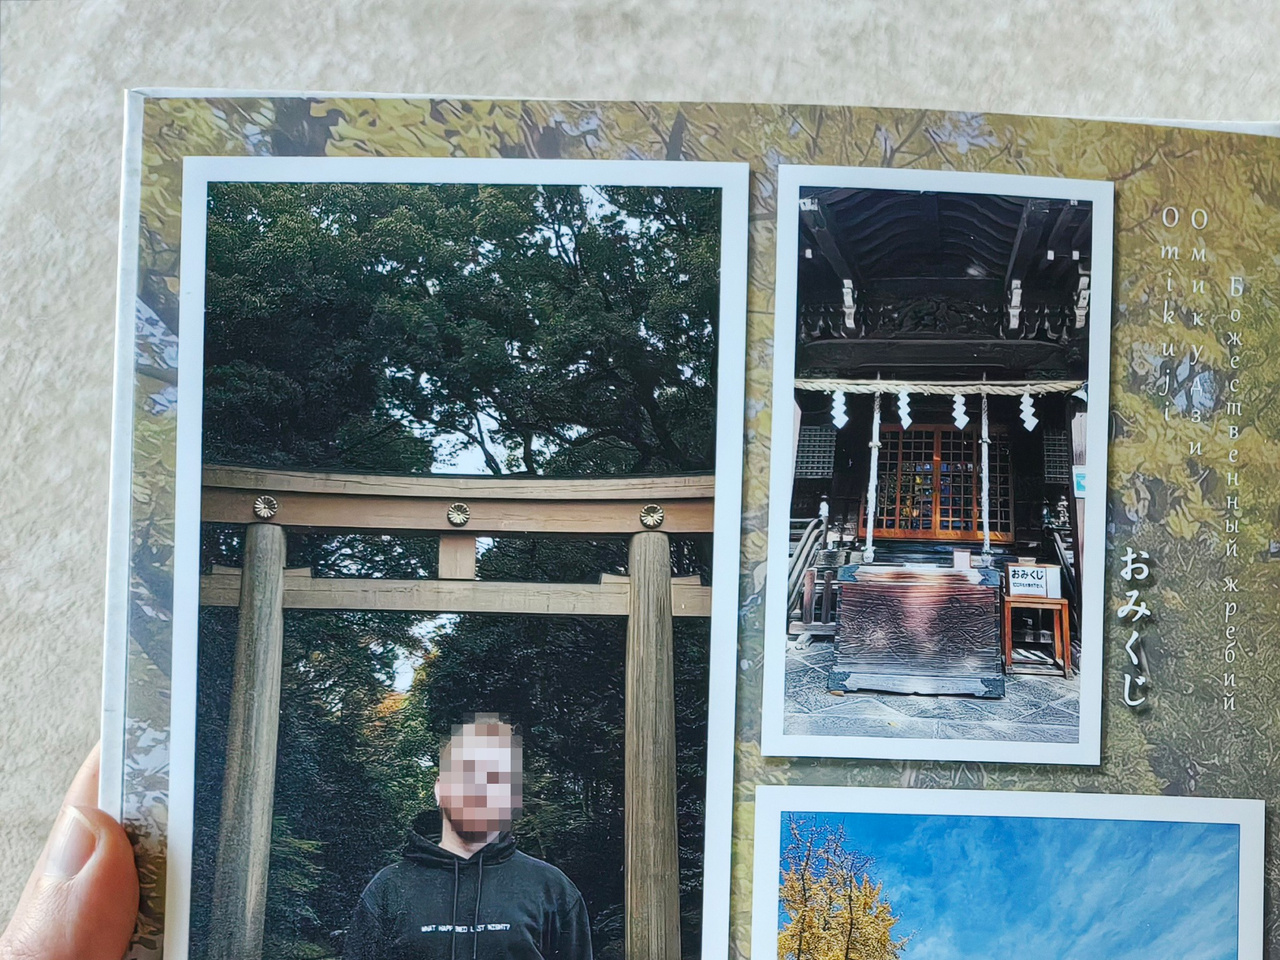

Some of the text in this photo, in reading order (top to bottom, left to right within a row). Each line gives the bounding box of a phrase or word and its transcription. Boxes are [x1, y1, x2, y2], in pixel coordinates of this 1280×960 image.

[1159, 206, 1179, 421] Omikuji
[1189, 208, 1208, 455] Омикудзи
[1011, 569, 1044, 581] おみくじ
[1222, 276, 1244, 711] Божественный жребий
[1117, 546, 1151, 707] おみくじ
